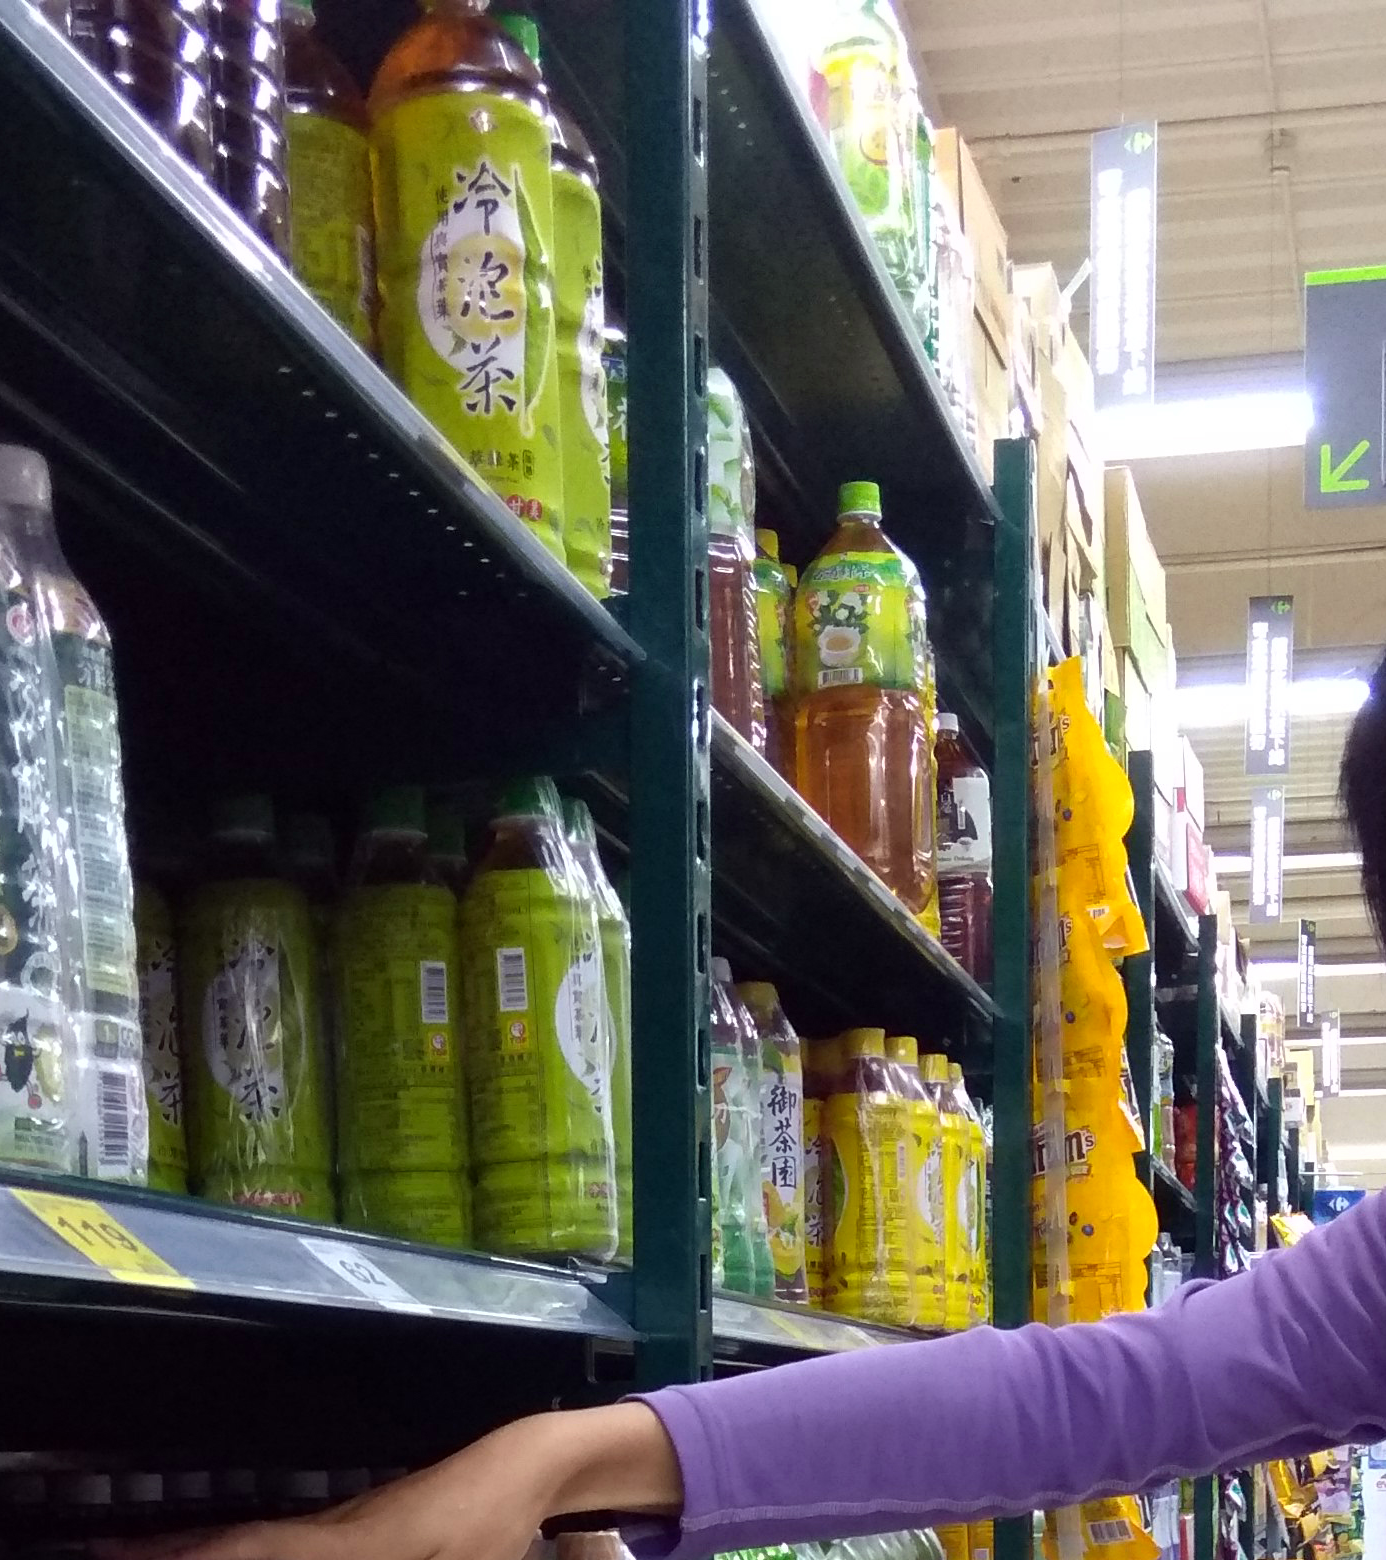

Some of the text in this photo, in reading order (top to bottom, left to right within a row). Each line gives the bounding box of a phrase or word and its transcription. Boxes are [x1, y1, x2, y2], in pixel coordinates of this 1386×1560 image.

[453, 160, 517, 415] 冷泡茶
[767, 1084, 797, 1190] 御茶園
[56, 1214, 139, 1254] 119
